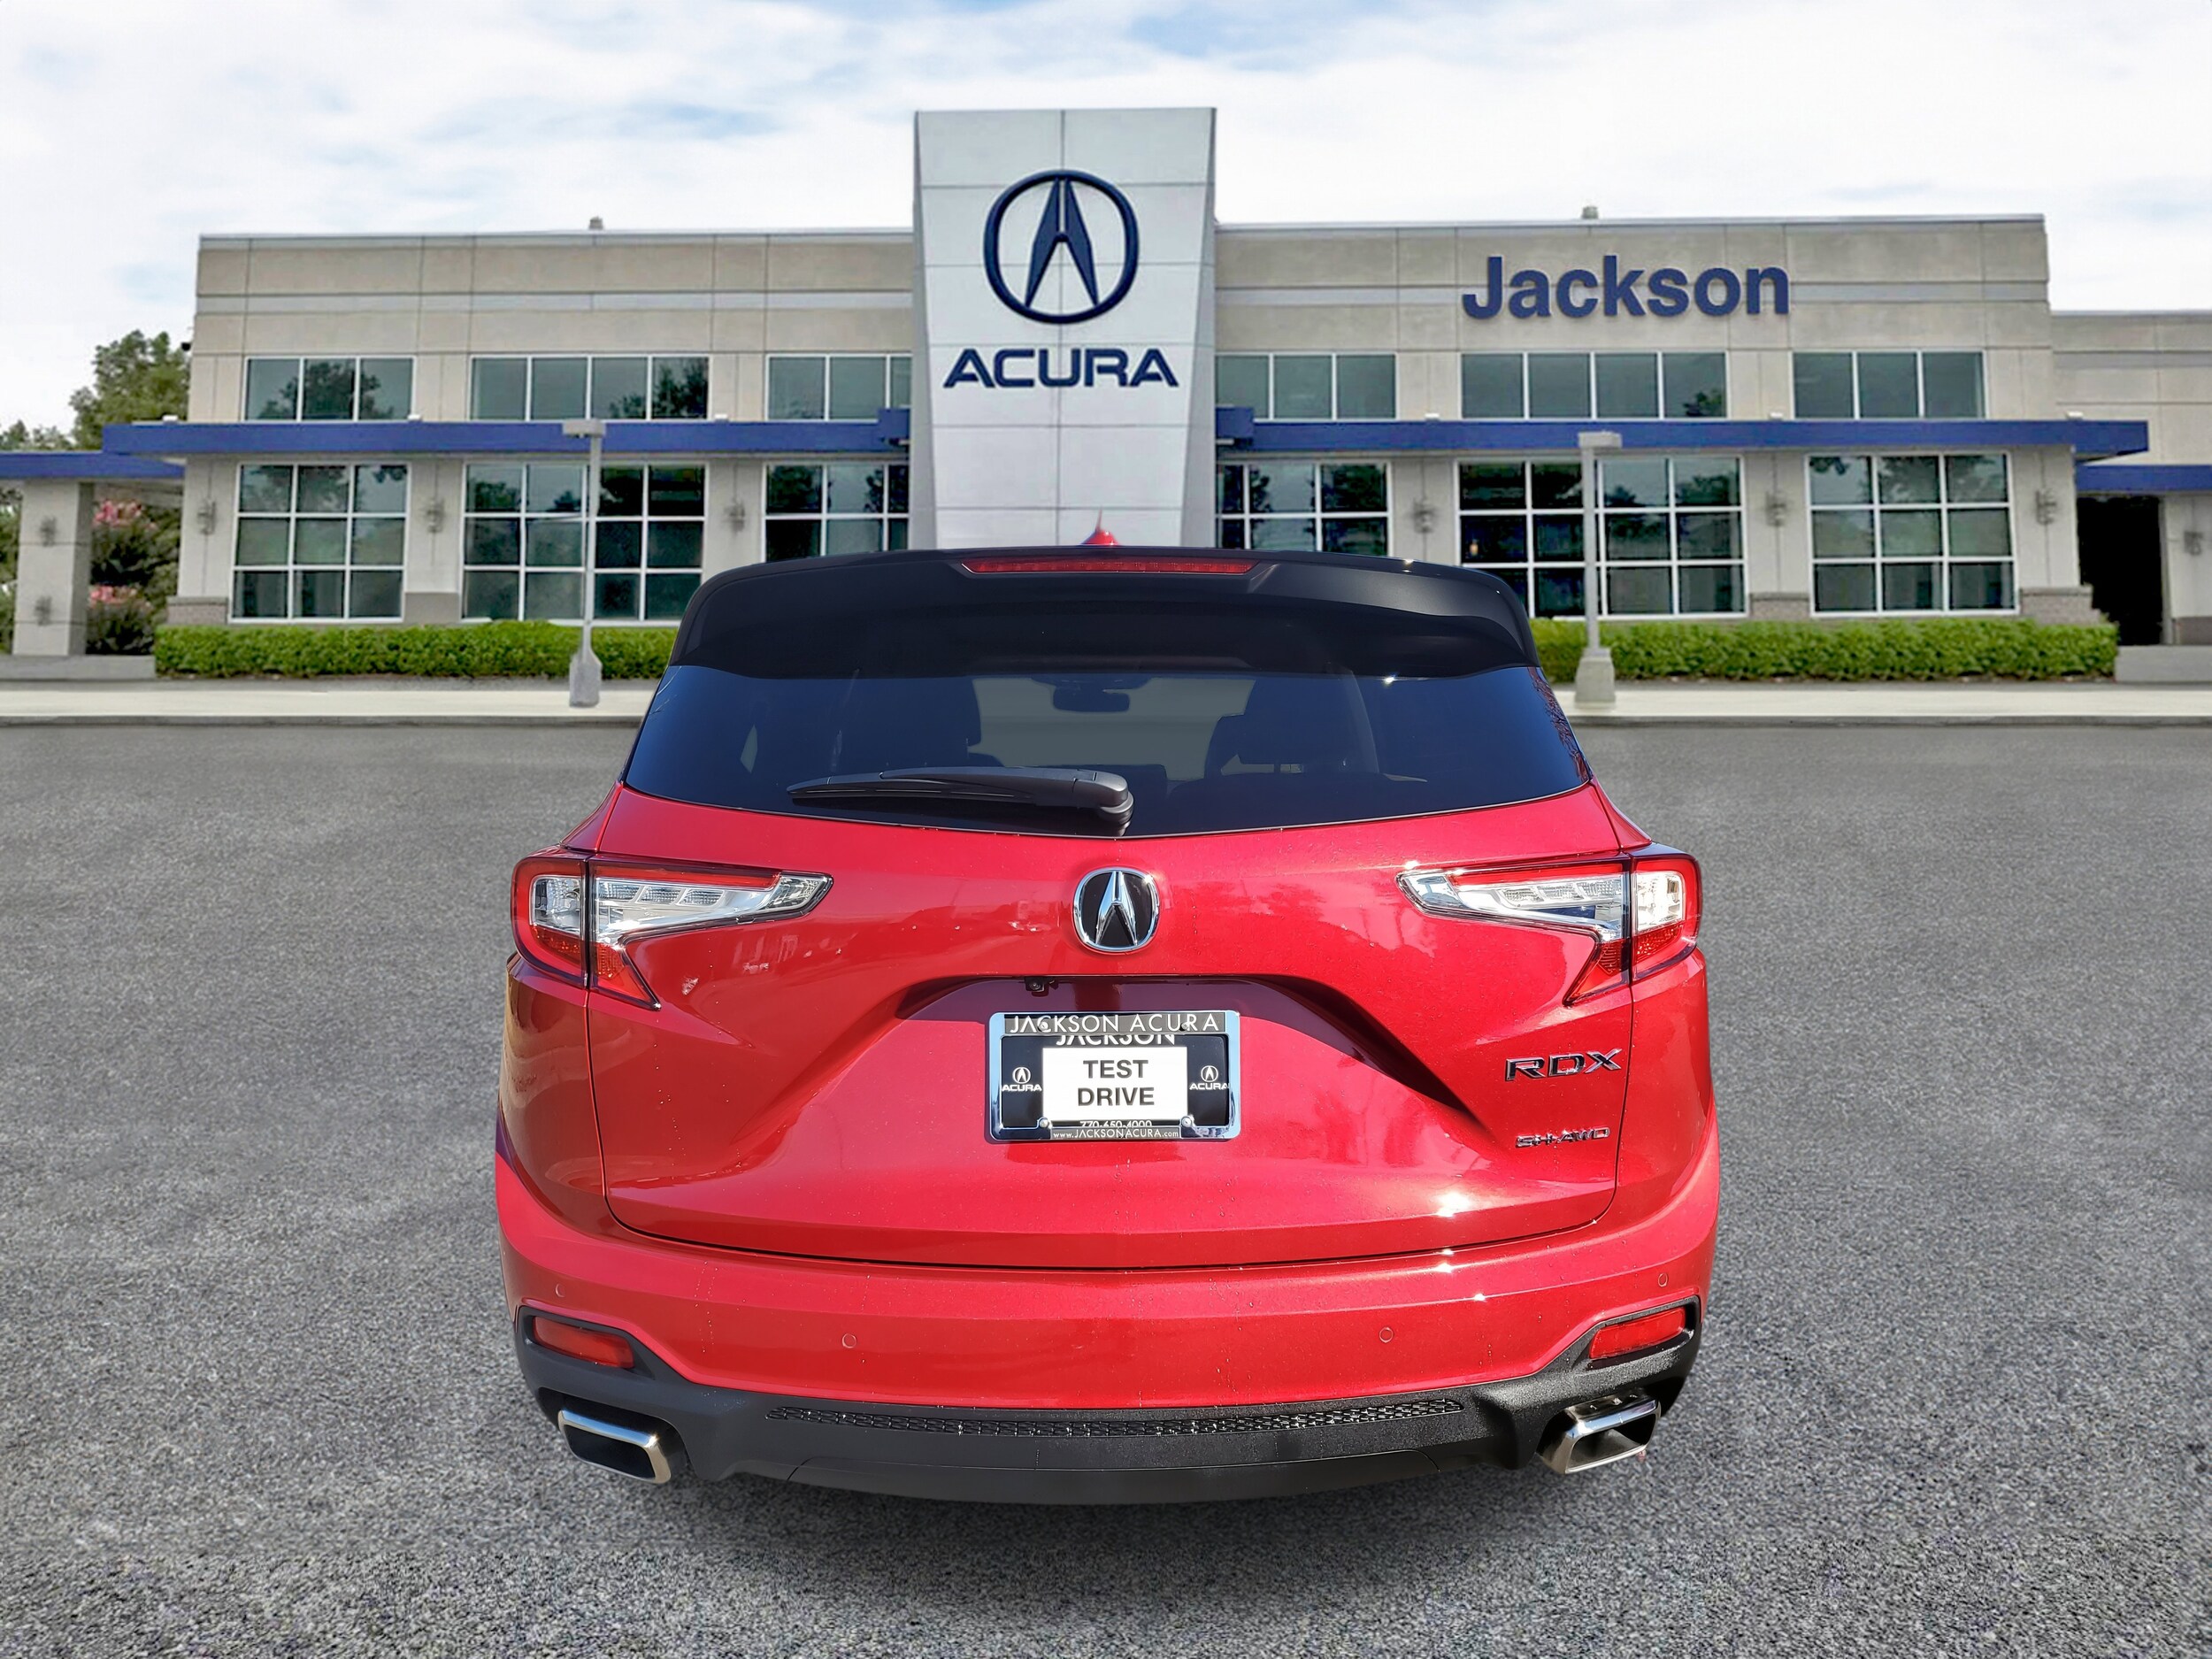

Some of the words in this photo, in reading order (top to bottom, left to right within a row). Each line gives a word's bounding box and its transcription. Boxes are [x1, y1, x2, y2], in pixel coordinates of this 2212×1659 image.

[1462, 255, 1790, 319] Jackson
[942, 348, 1179, 388] ACURA
[1010, 1014, 1119, 1033] JACKSON
[1129, 1013, 1219, 1032] ACURA
[1082, 1059, 1149, 1079] TEST
[1505, 1048, 1623, 1081] RDX
[1077, 1087, 1155, 1106] DRIVE
[1052, 1128, 1179, 1139] www.JACKSONACURA.com
